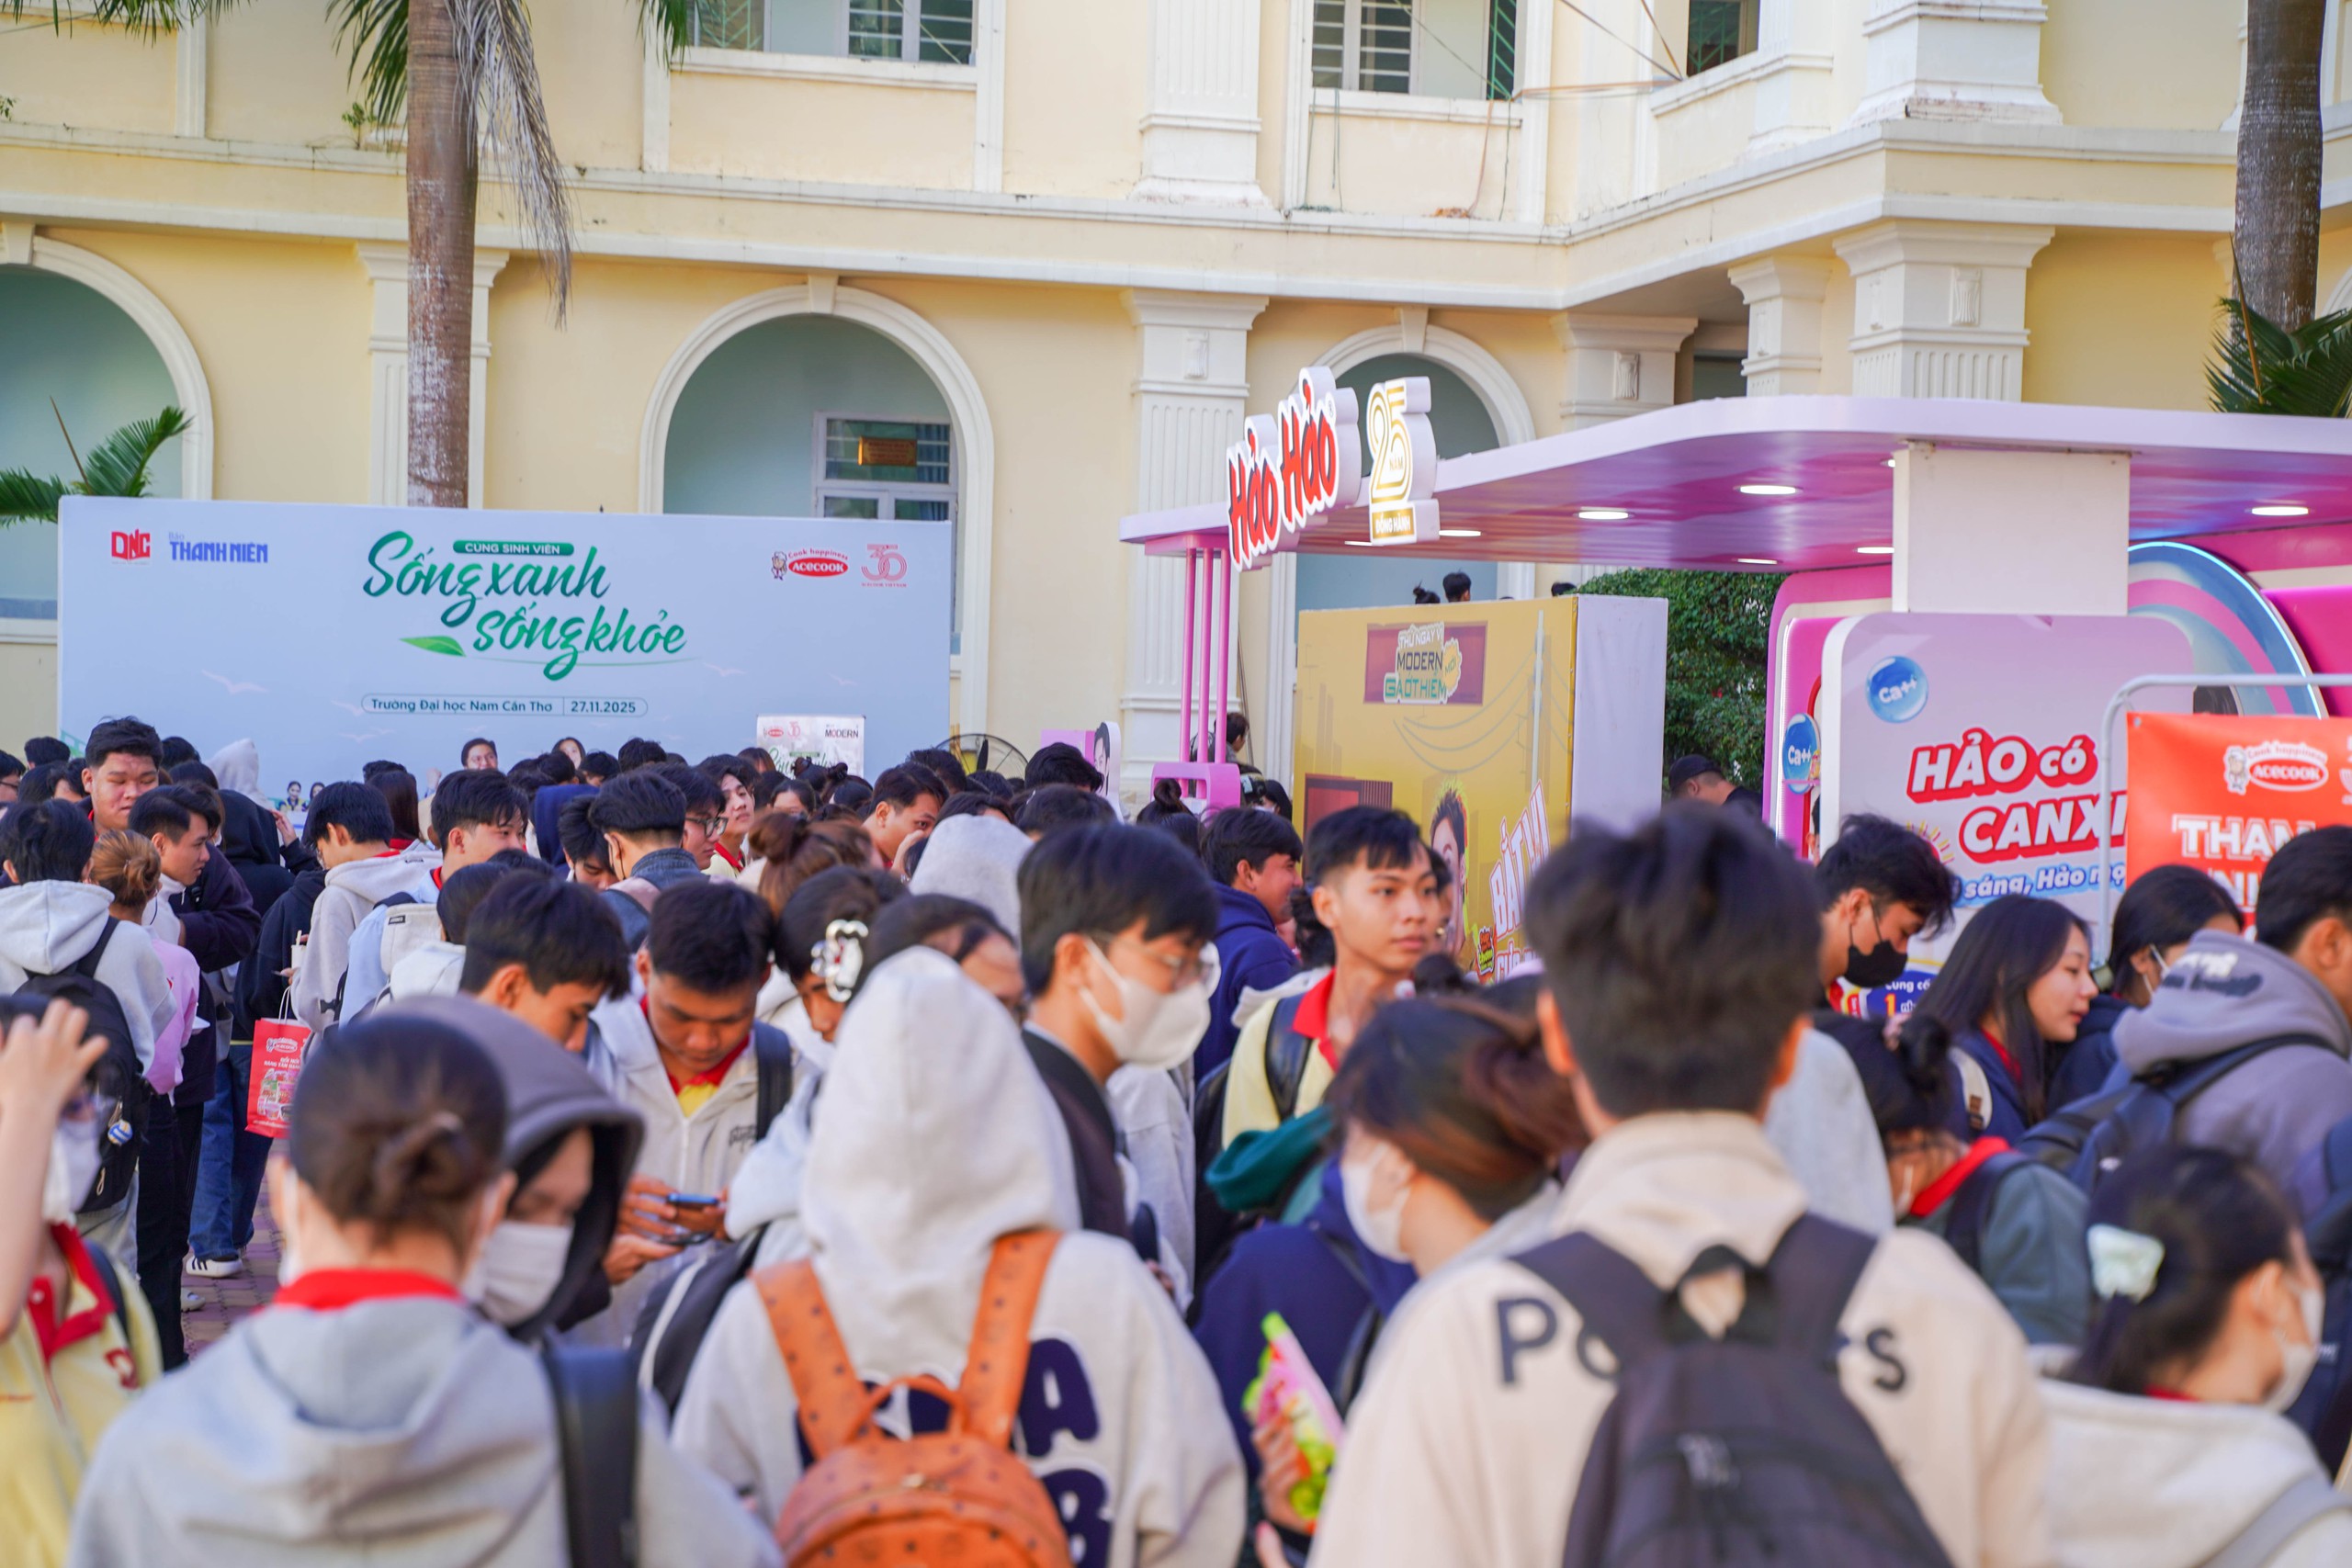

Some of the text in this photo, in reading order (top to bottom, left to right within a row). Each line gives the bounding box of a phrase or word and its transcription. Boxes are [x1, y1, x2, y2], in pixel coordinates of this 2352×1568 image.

[1369, 385, 1411, 504] 25
[1228, 378, 1337, 565] Hảo Hảo
[111, 528, 151, 560] DNC
[170, 541, 268, 563] THANH NIÊN
[465, 541, 560, 556] CÙNG SINH VIÊN
[363, 530, 611, 627] Sống xanh
[473, 601, 687, 681] sống khỏe
[1396, 651, 1443, 671] MODERN
[371, 698, 415, 712] Trường
[419, 698, 440, 712] Đại
[443, 699, 466, 714] học
[469, 700, 499, 712] Nam
[529, 700, 553, 713] Thơ
[571, 700, 636, 714] 27.11.2025
[824, 728, 859, 739] MODERN
[1910, 731, 2088, 795] HẢO có
[1962, 794, 2127, 854] CANXI
[2037, 863, 2086, 890] Hảo
